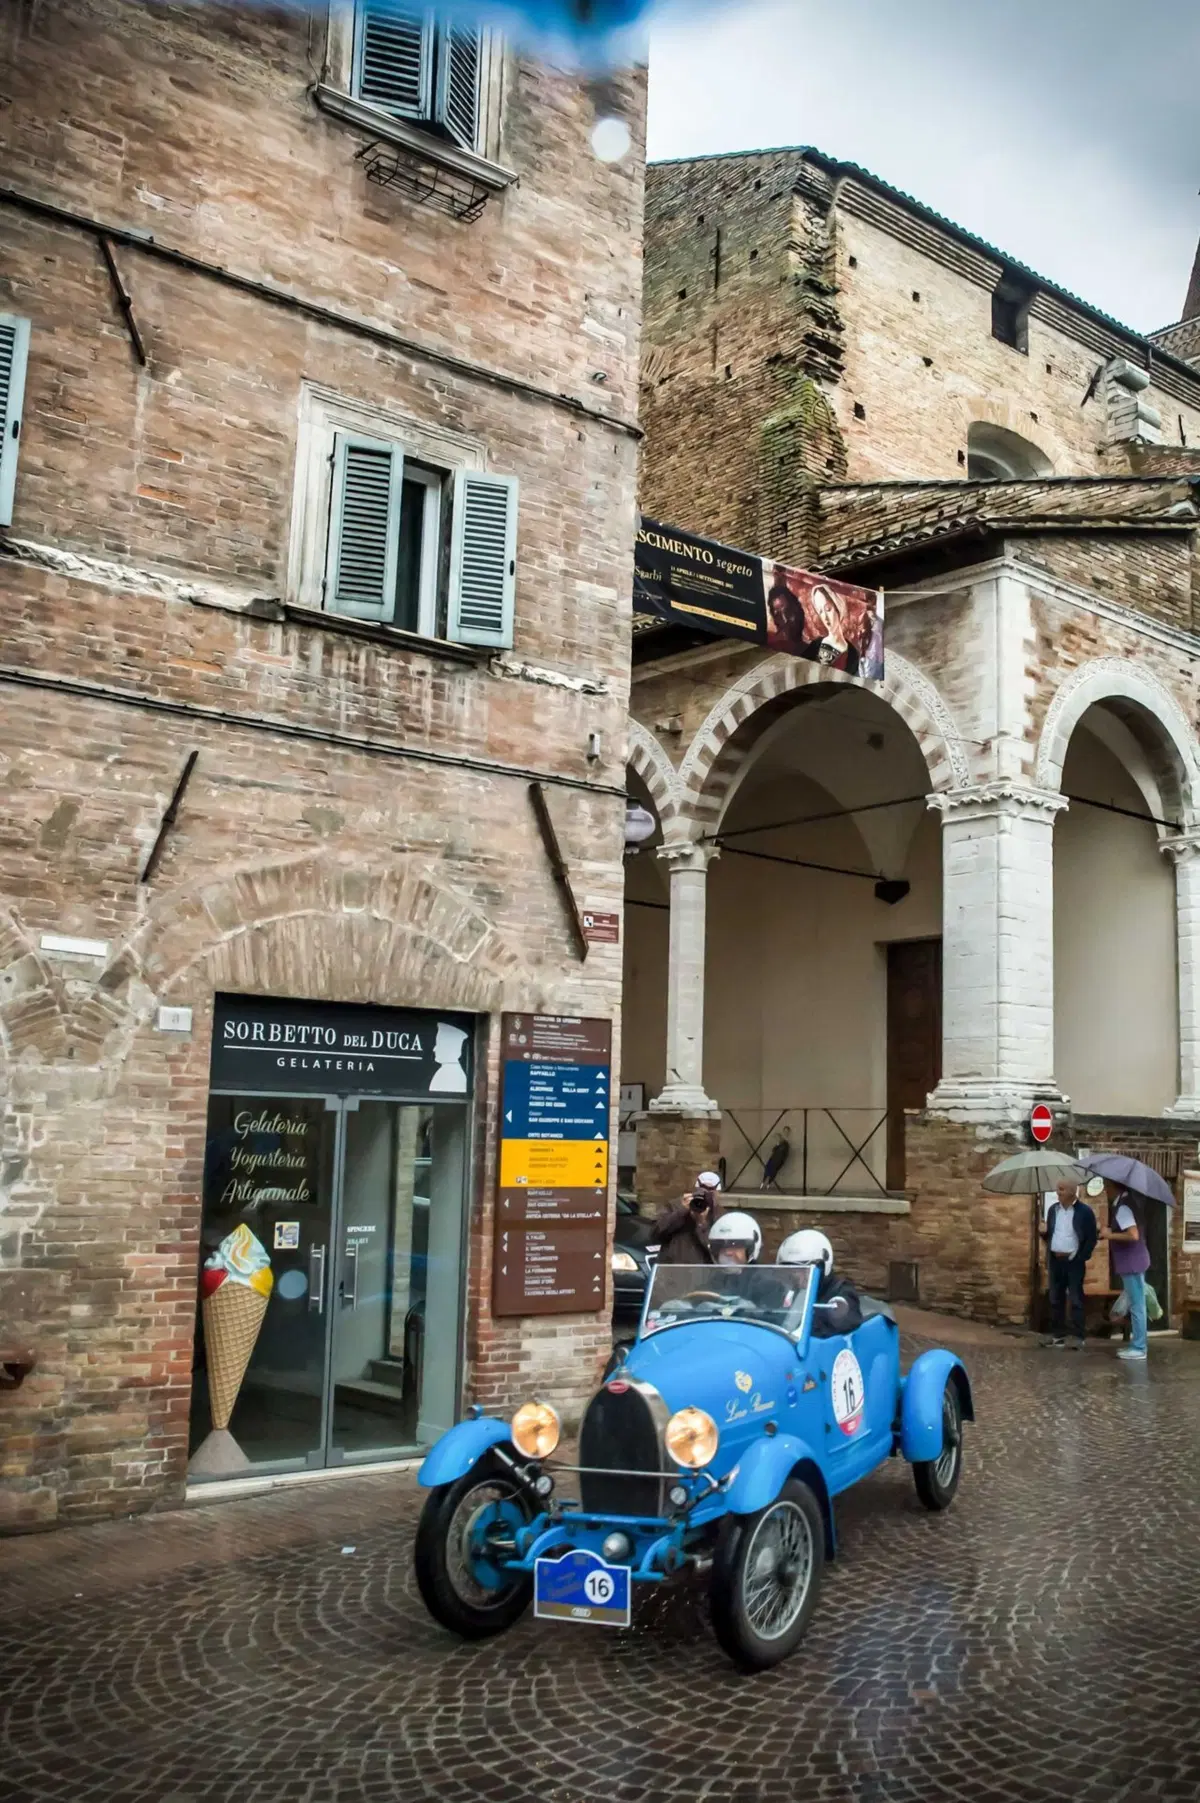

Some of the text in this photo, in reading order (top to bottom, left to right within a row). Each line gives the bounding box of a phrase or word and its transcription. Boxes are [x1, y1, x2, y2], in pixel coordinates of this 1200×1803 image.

[635, 565, 662, 581] Sgarbi
[716, 559, 753, 578] segreto
[223, 1020, 423, 1051] SORBETTO DEL DUCA
[276, 1057, 375, 1072] GELATERIA
[234, 1110, 308, 1139] Gelateria
[230, 1146, 307, 1175] Yogurteria
[220, 1177, 310, 1209] Artigianale
[843, 1376, 856, 1413] 16
[588, 1577, 610, 1598] 16
